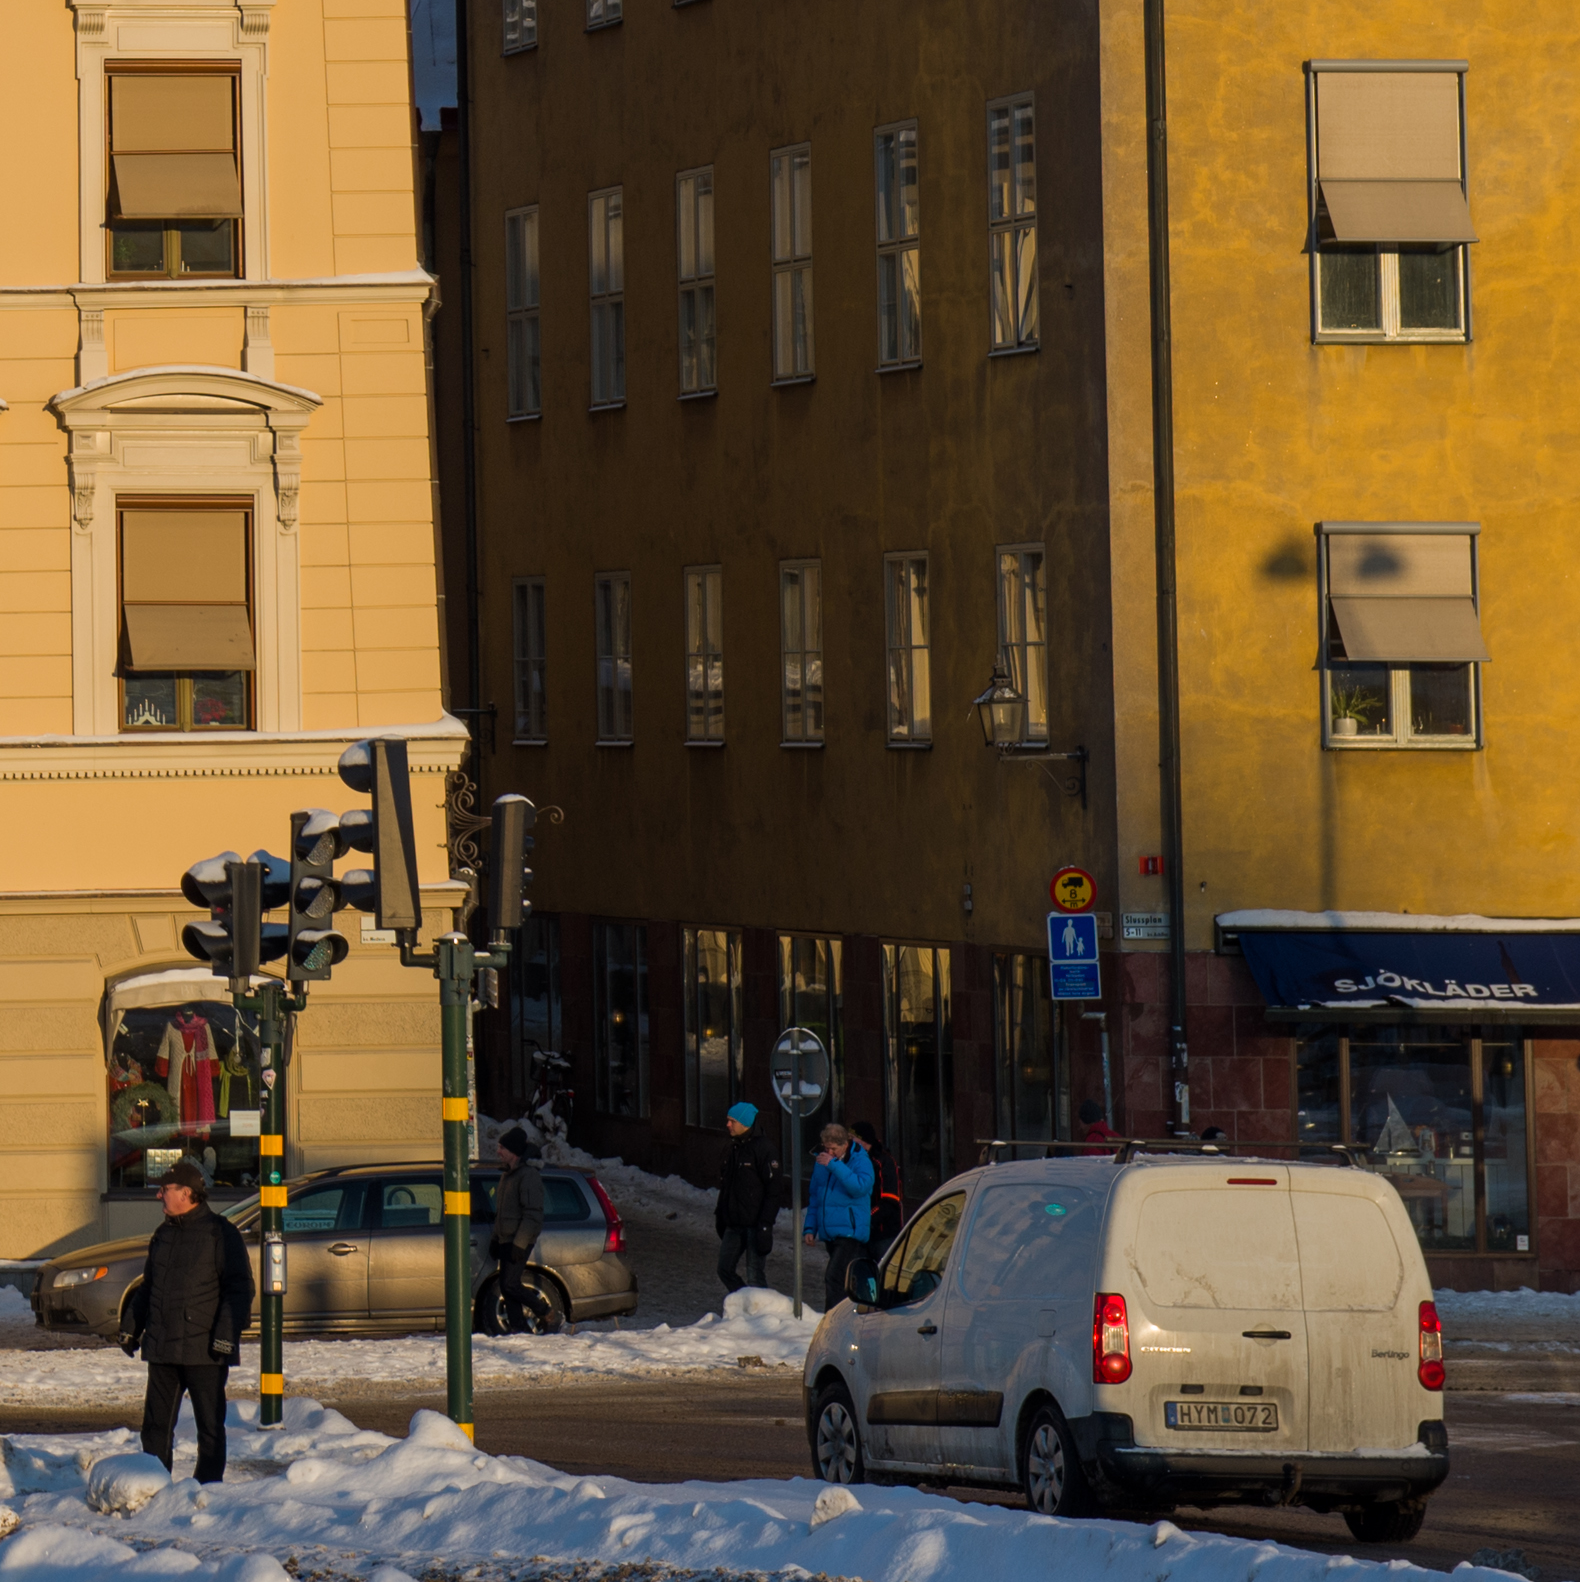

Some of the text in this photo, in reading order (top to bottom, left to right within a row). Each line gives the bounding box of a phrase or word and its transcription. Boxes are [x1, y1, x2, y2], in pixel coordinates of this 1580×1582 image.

[1069, 889, 1078, 899] 8
[1125, 915, 1162, 925] Slussplan
[1333, 969, 1539, 998] SJÖKLÄDER
[1371, 1349, 1410, 1360] Berlingo
[1179, 1407, 1273, 1425] HYM 072
